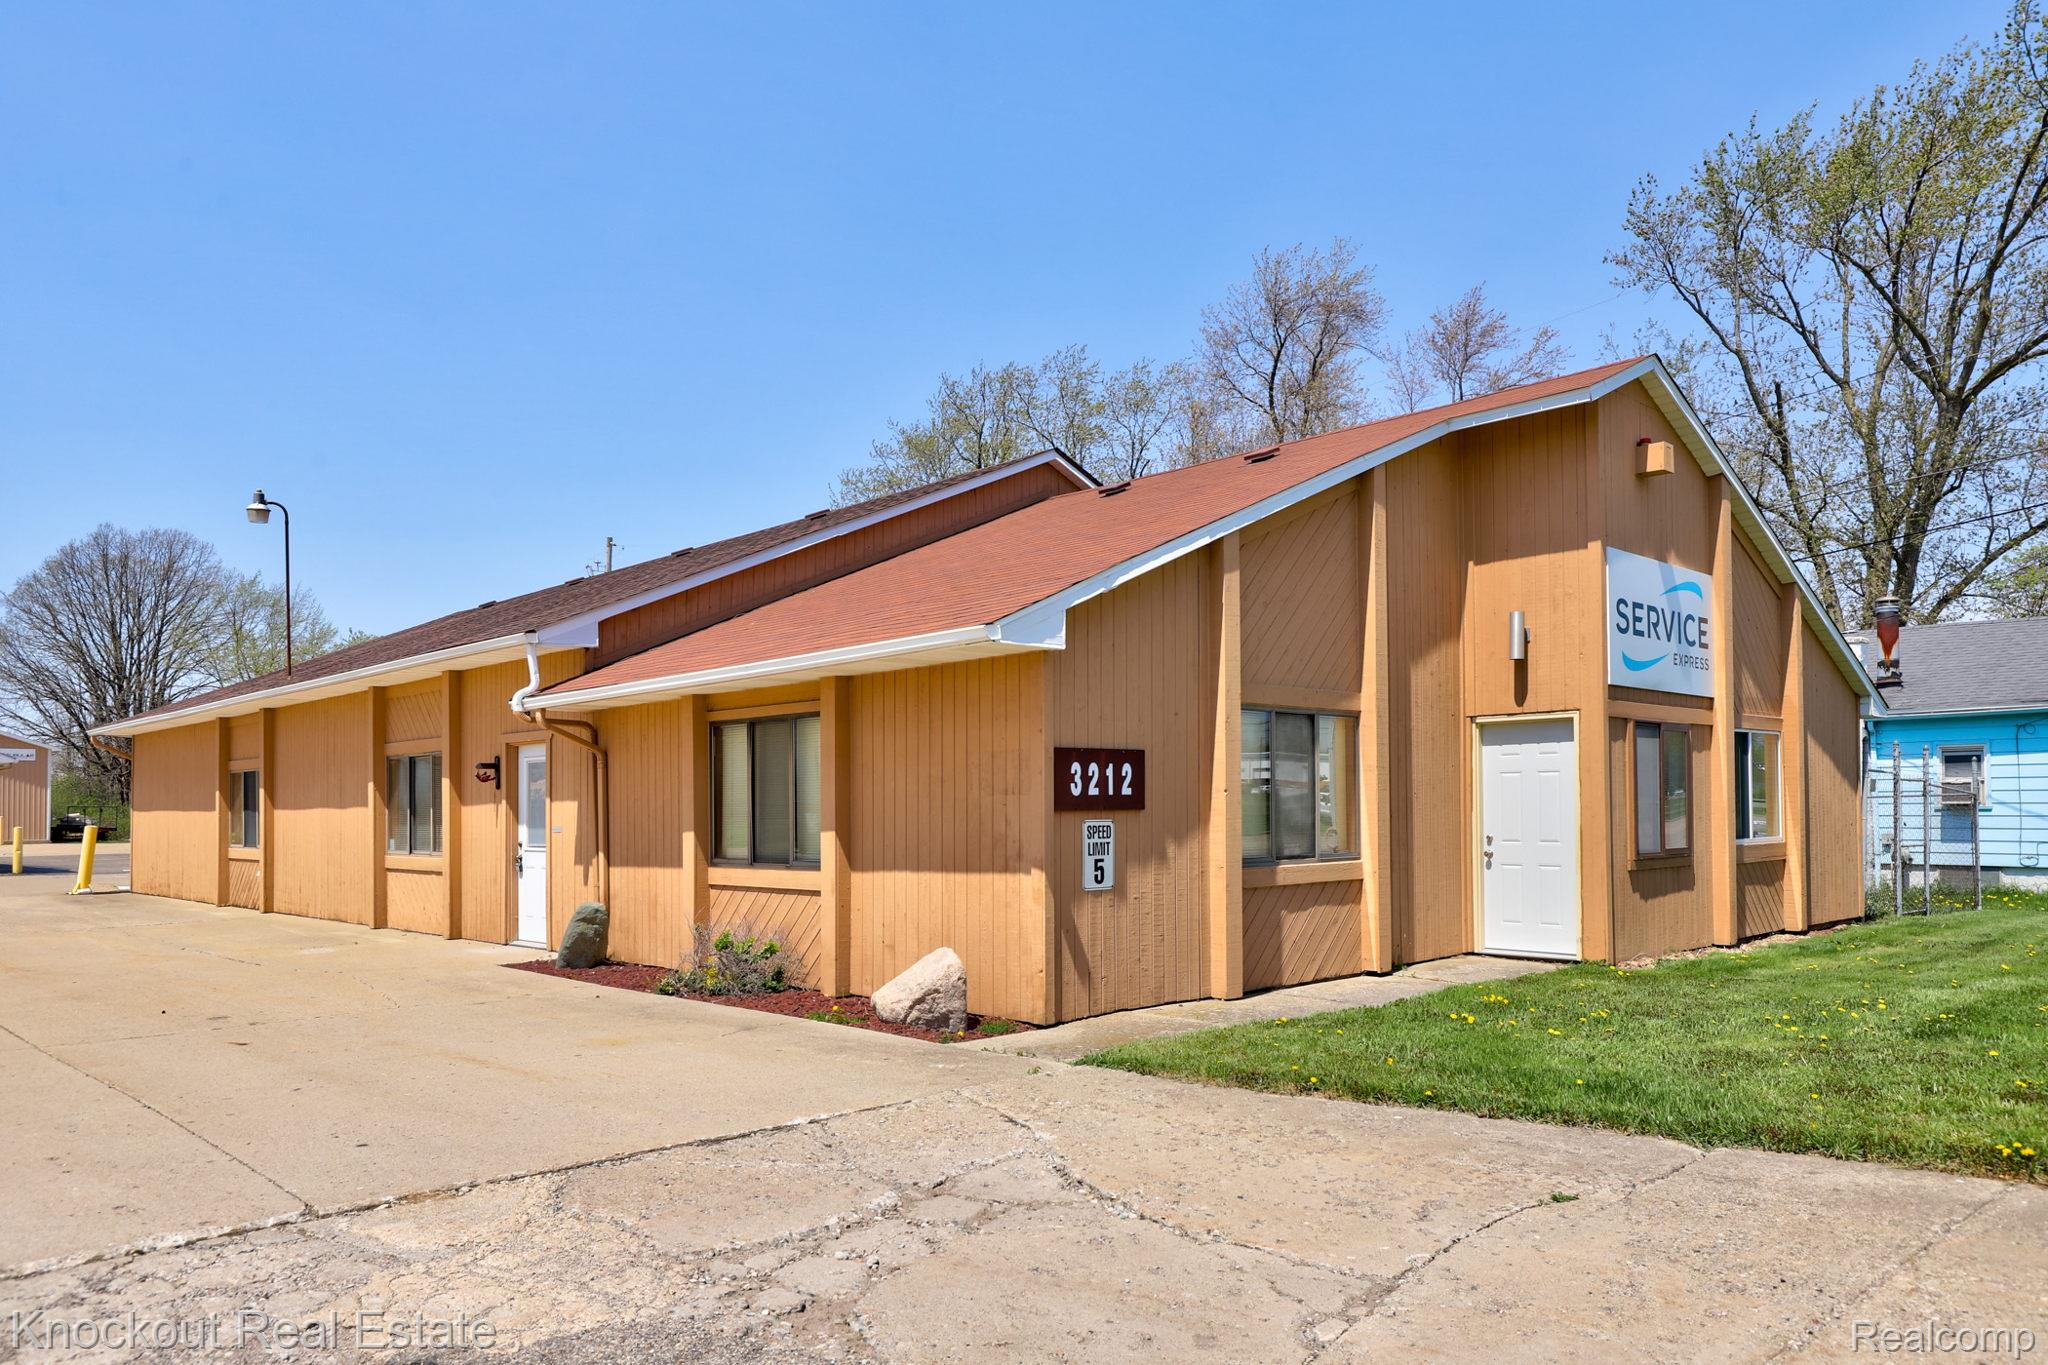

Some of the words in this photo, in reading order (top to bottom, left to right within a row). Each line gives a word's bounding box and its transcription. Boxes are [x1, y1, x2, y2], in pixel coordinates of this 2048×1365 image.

[1616, 598, 1709, 650] SERVICE
[1673, 653, 1710, 671] EXPRESS
[1070, 761, 1133, 797] 3212
[1086, 825, 1112, 840] SPEED
[1087, 841, 1111, 857] LIMIT
[1093, 858, 1105, 885] 5
